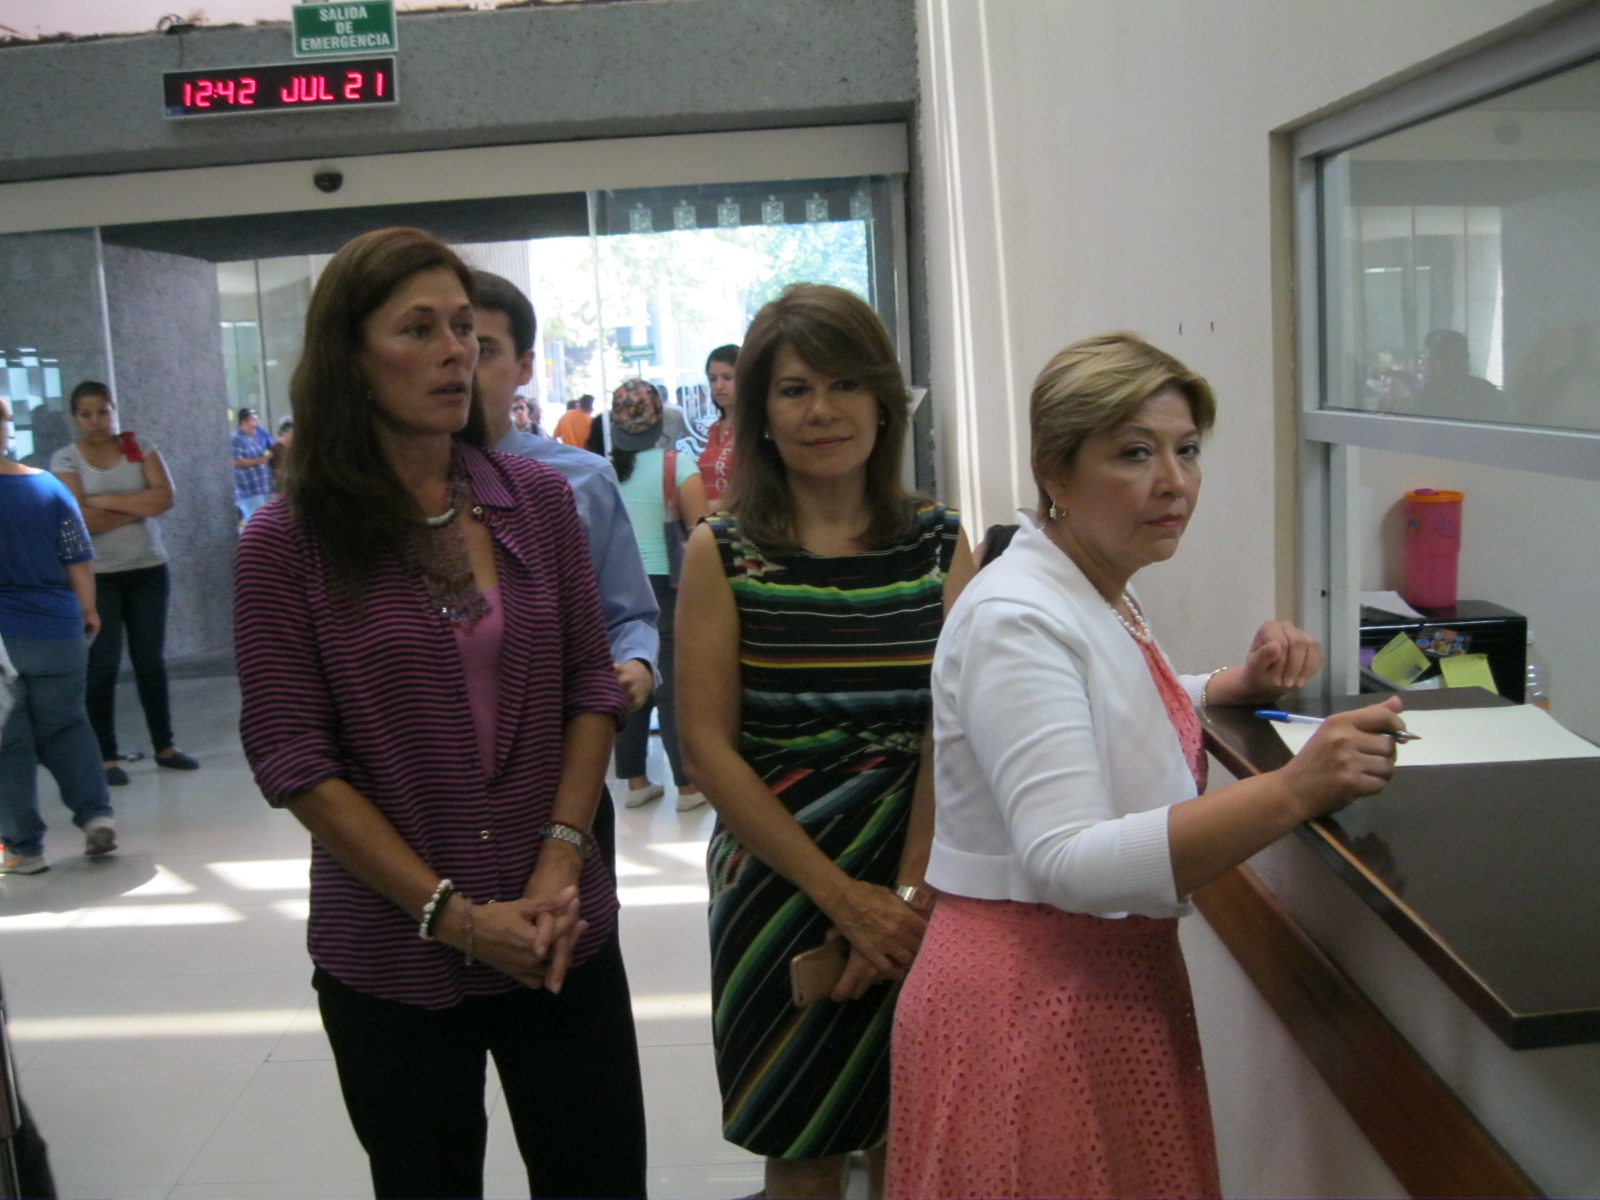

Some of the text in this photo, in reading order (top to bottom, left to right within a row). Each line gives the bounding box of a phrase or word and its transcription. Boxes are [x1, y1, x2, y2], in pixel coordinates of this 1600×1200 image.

[319, 6, 368, 21] SALIDA
[335, 21, 354, 34] DE
[301, 33, 390, 51] EMERGENCIA
[280, 75, 334, 102] JUL
[344, 71, 384, 99] 21
